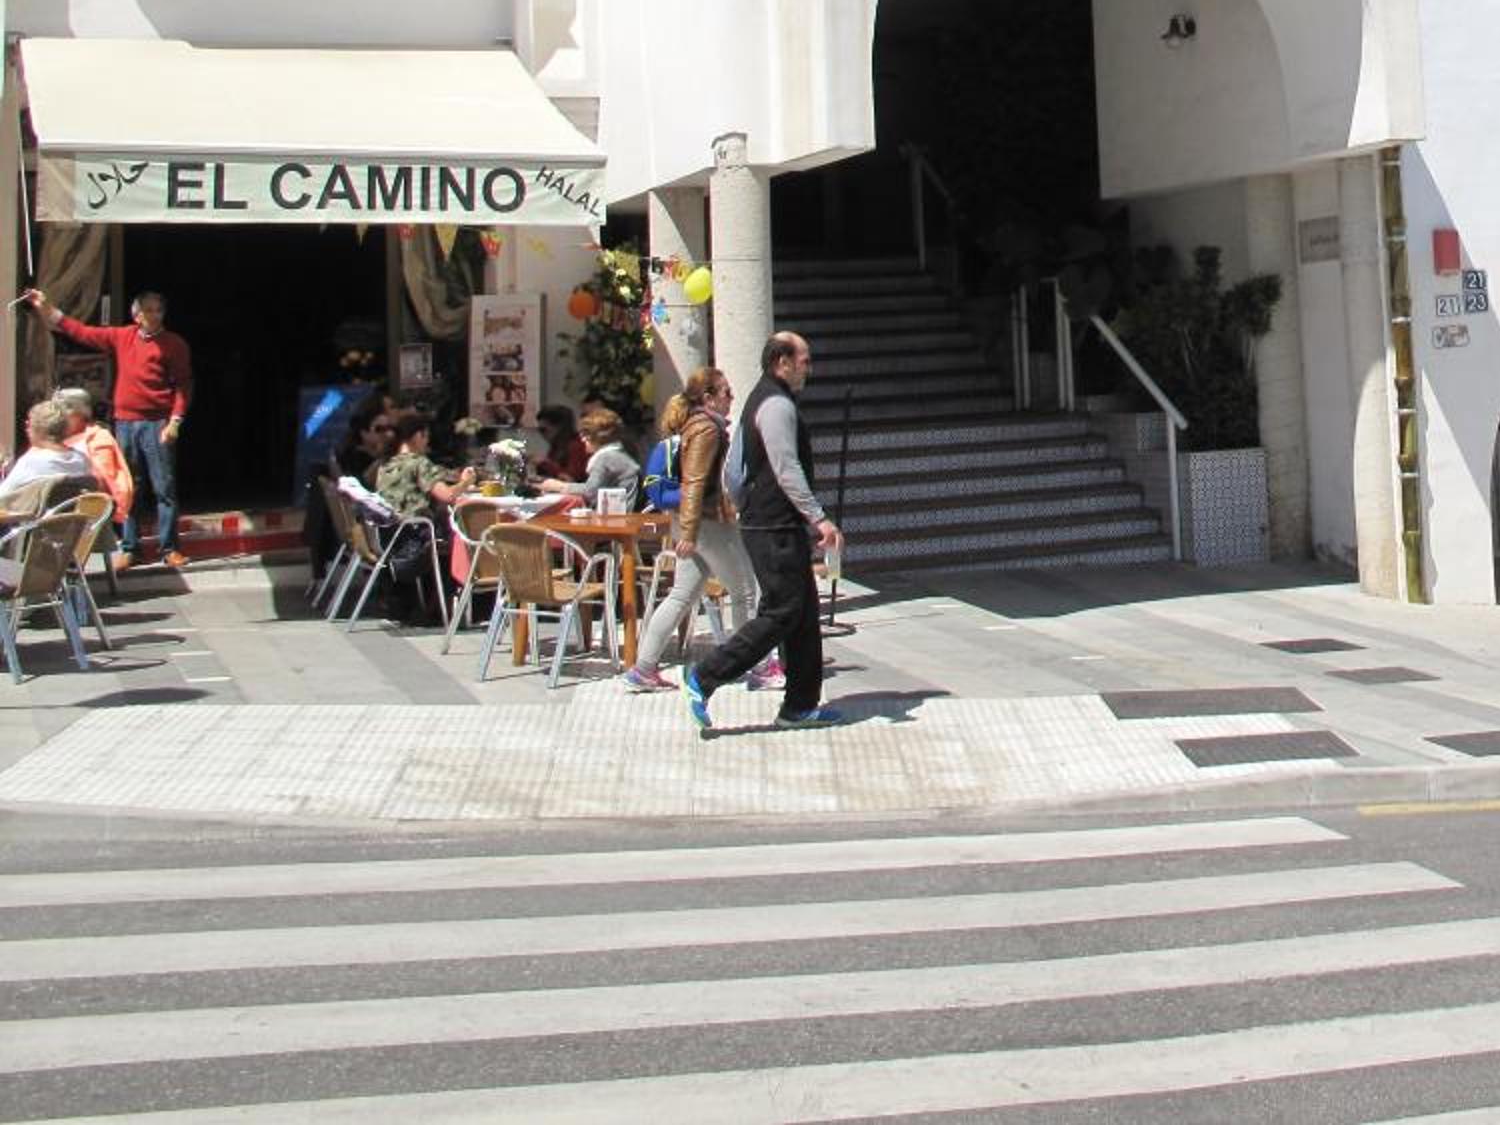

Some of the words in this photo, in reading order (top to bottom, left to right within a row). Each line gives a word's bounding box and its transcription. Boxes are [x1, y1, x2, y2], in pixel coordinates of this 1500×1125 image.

[167, 162, 248, 210] EL
[270, 163, 527, 213] CAMINO
[534, 165, 602, 217] HALAL
[1467, 272, 1484, 289] 21
[1467, 294, 1488, 312] 23
